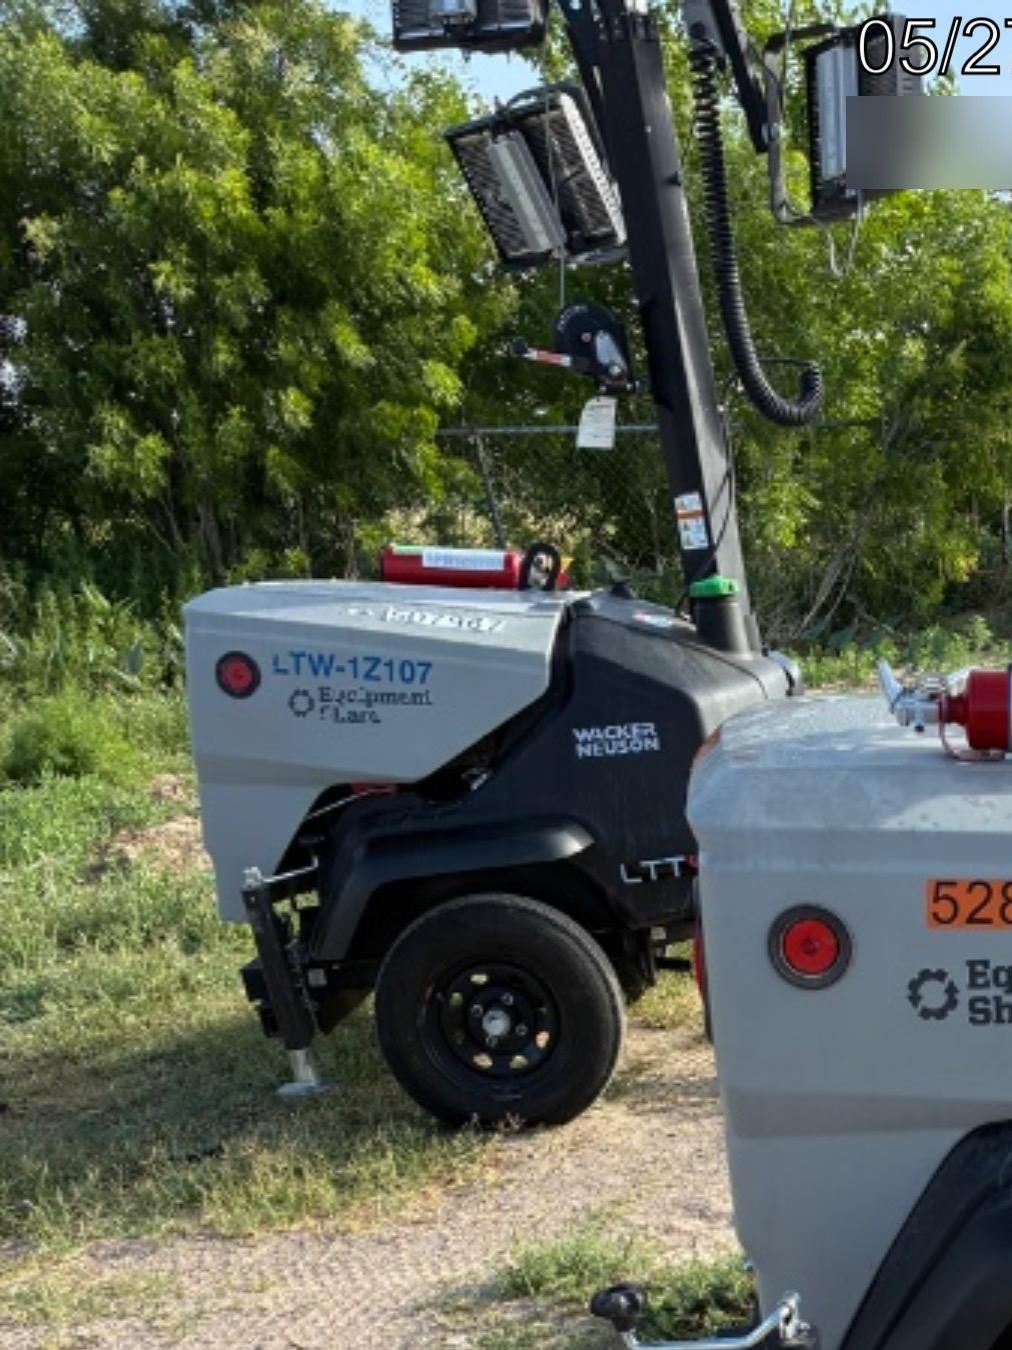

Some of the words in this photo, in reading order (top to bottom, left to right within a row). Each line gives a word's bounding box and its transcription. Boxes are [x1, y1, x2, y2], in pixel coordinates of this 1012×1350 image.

[271, 650, 433, 685] LTW-1Z107
[573, 722, 658, 743] WACKER
[576, 737, 660, 758] NEUSON
